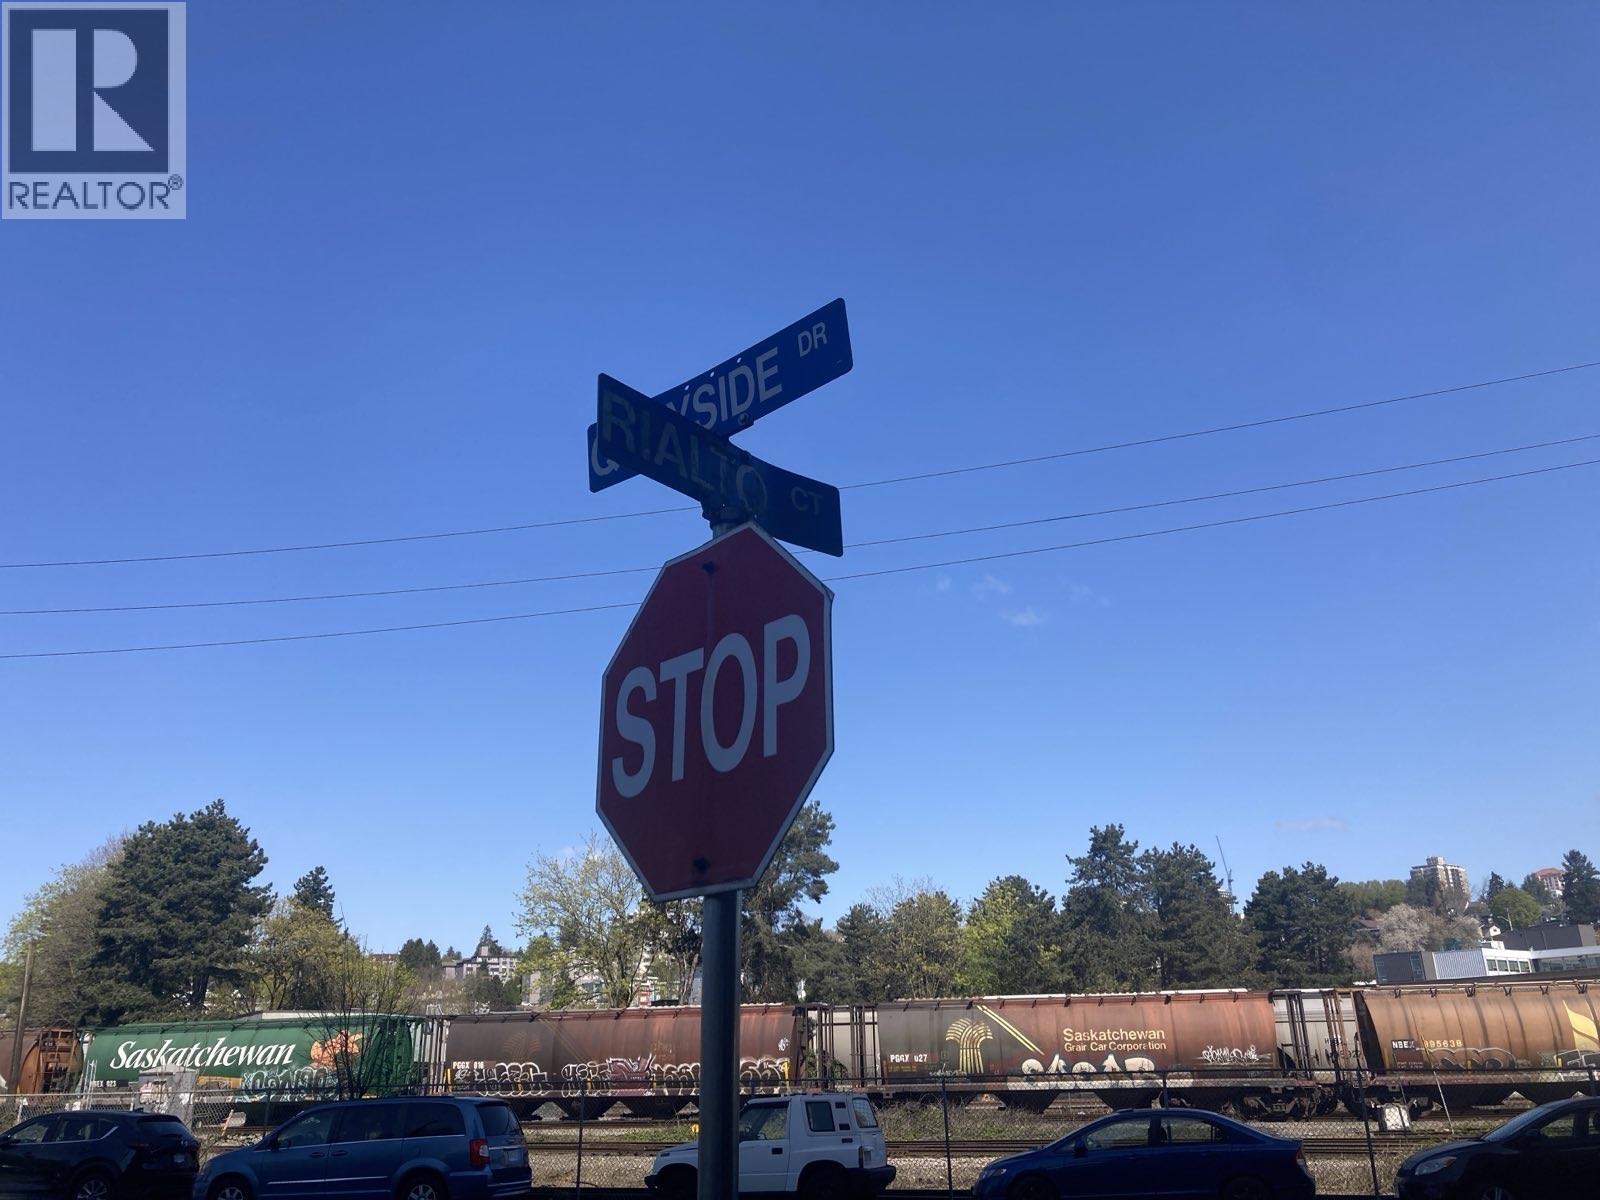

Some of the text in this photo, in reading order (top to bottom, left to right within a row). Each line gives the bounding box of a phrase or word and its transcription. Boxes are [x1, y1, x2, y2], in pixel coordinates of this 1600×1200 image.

[591, 321, 828, 477] QSIDE DR
[602, 391, 824, 515] RIALTO CT
[612, 614, 811, 798] STOP
[109, 1037, 297, 1070] Saskatchewan
[1063, 1028, 1165, 1042] Saskatchewan
[1090, 1042, 1107, 1052] Car
[1109, 1041, 1167, 1051] Corporation
